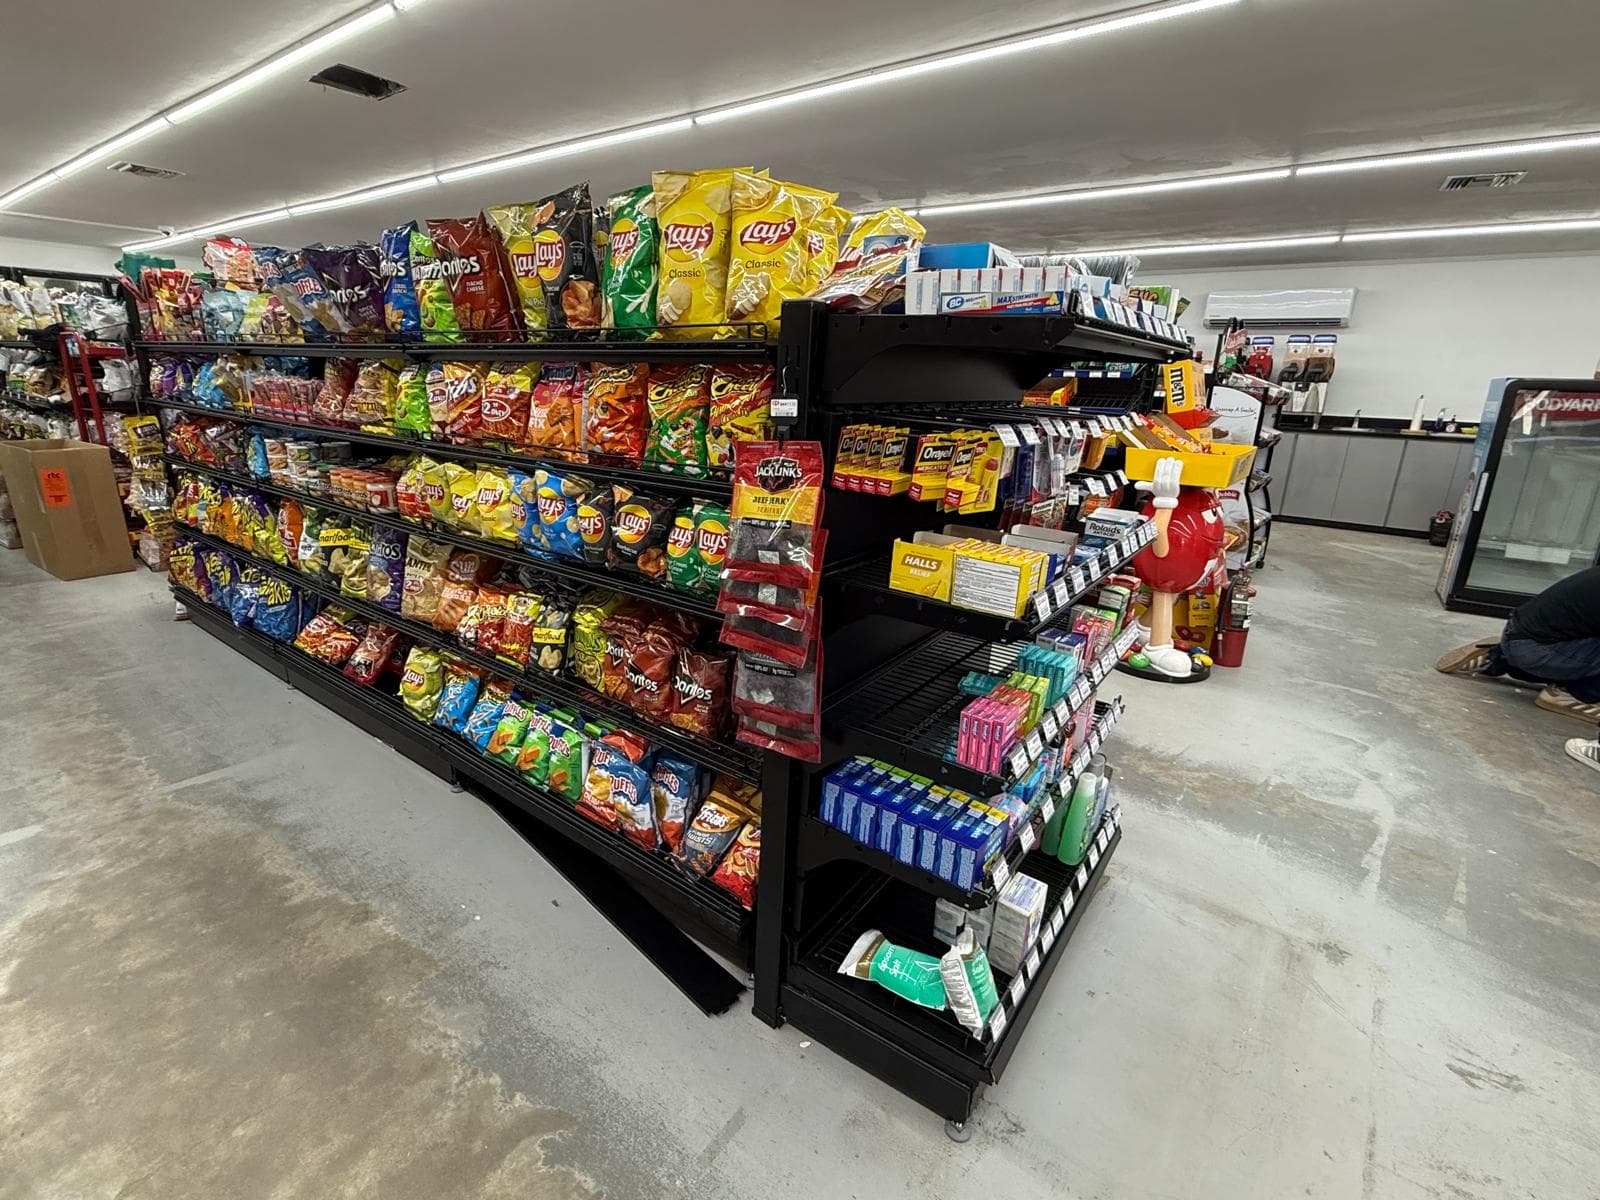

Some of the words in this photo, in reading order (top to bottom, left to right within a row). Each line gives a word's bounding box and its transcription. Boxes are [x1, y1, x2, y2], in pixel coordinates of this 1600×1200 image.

[665, 222, 712, 251] Lay's
[742, 218, 795, 245] Lay's
[746, 258, 781, 270] Classic
[668, 267, 702, 279] Classic
[949, 297, 962, 309] BC
[997, 296, 1012, 305] MAX
[923, 445, 954, 460] Orajel
[754, 465, 774, 478] JACK
[619, 511, 650, 535] Lay's
[1089, 522, 1121, 535] Rolaids
[699, 529, 729, 554] Lay's
[905, 555, 938, 570] HALLS
